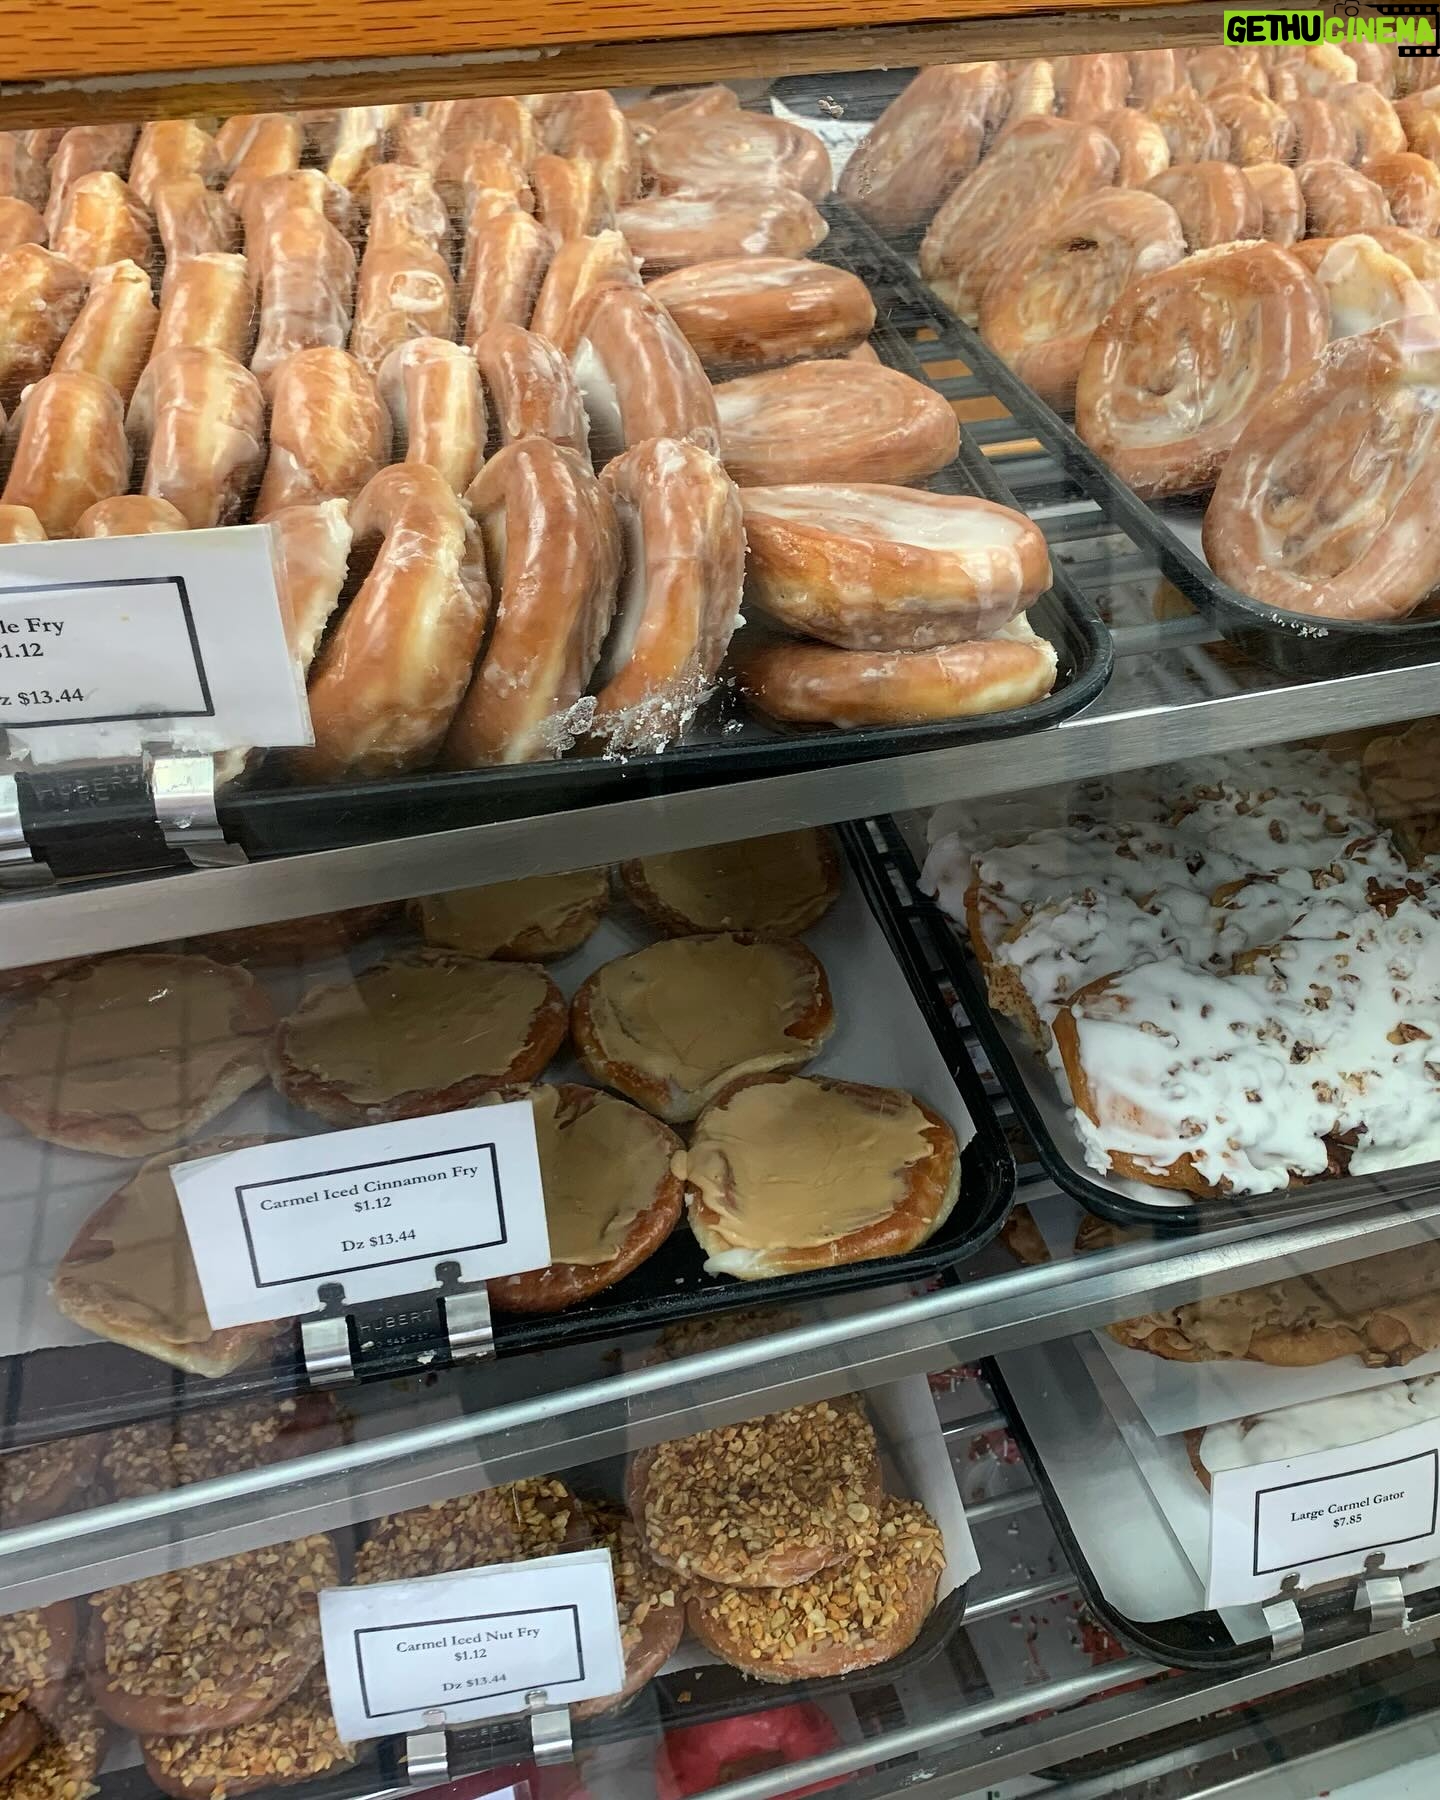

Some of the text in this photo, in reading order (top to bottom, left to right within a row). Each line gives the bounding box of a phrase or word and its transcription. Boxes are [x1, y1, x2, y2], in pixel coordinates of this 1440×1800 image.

[24, 617, 65, 637] Fry
[0, 642, 44, 659] 1.12
[17, 687, 84, 706] $13.44
[260, 1165, 478, 1211] Carmel Iced Cinnamon Fry
[353, 1196, 392, 1213] $1.12
[341, 1228, 416, 1252] Dz $13.44
[359, 1309, 433, 1332] HUBERT
[1291, 1490, 1405, 1522] Large Carmel Gator
[1332, 1513, 1363, 1529] $7.85
[396, 1627, 540, 1653] Carmel Iced Nut Fry
[454, 1648, 487, 1662] $1.12
[442, 1673, 507, 1692] Dz $13.44
